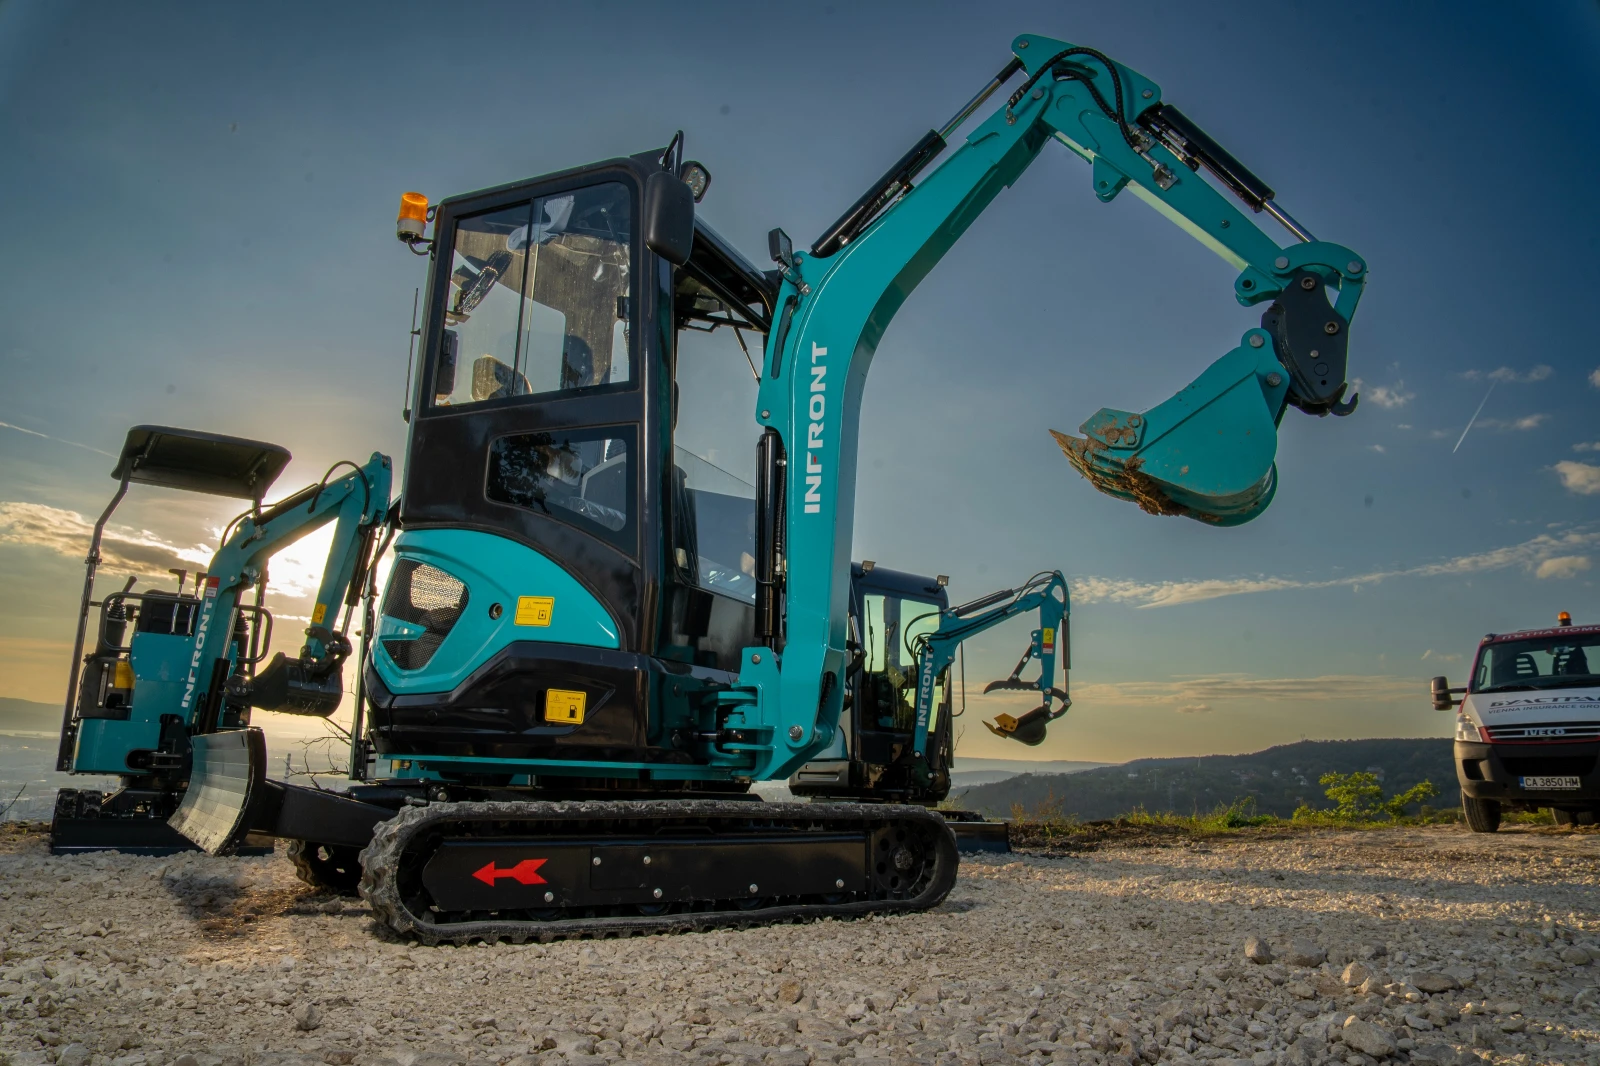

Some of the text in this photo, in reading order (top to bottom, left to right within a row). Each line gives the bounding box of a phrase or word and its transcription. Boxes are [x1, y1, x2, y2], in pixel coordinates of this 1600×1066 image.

[804, 341, 828, 514] INFRONT
[181, 598, 213, 708] INFRONT
[918, 652, 934, 727] INFRONT
[1525, 777, 1579, 787] CA 3850 HM
